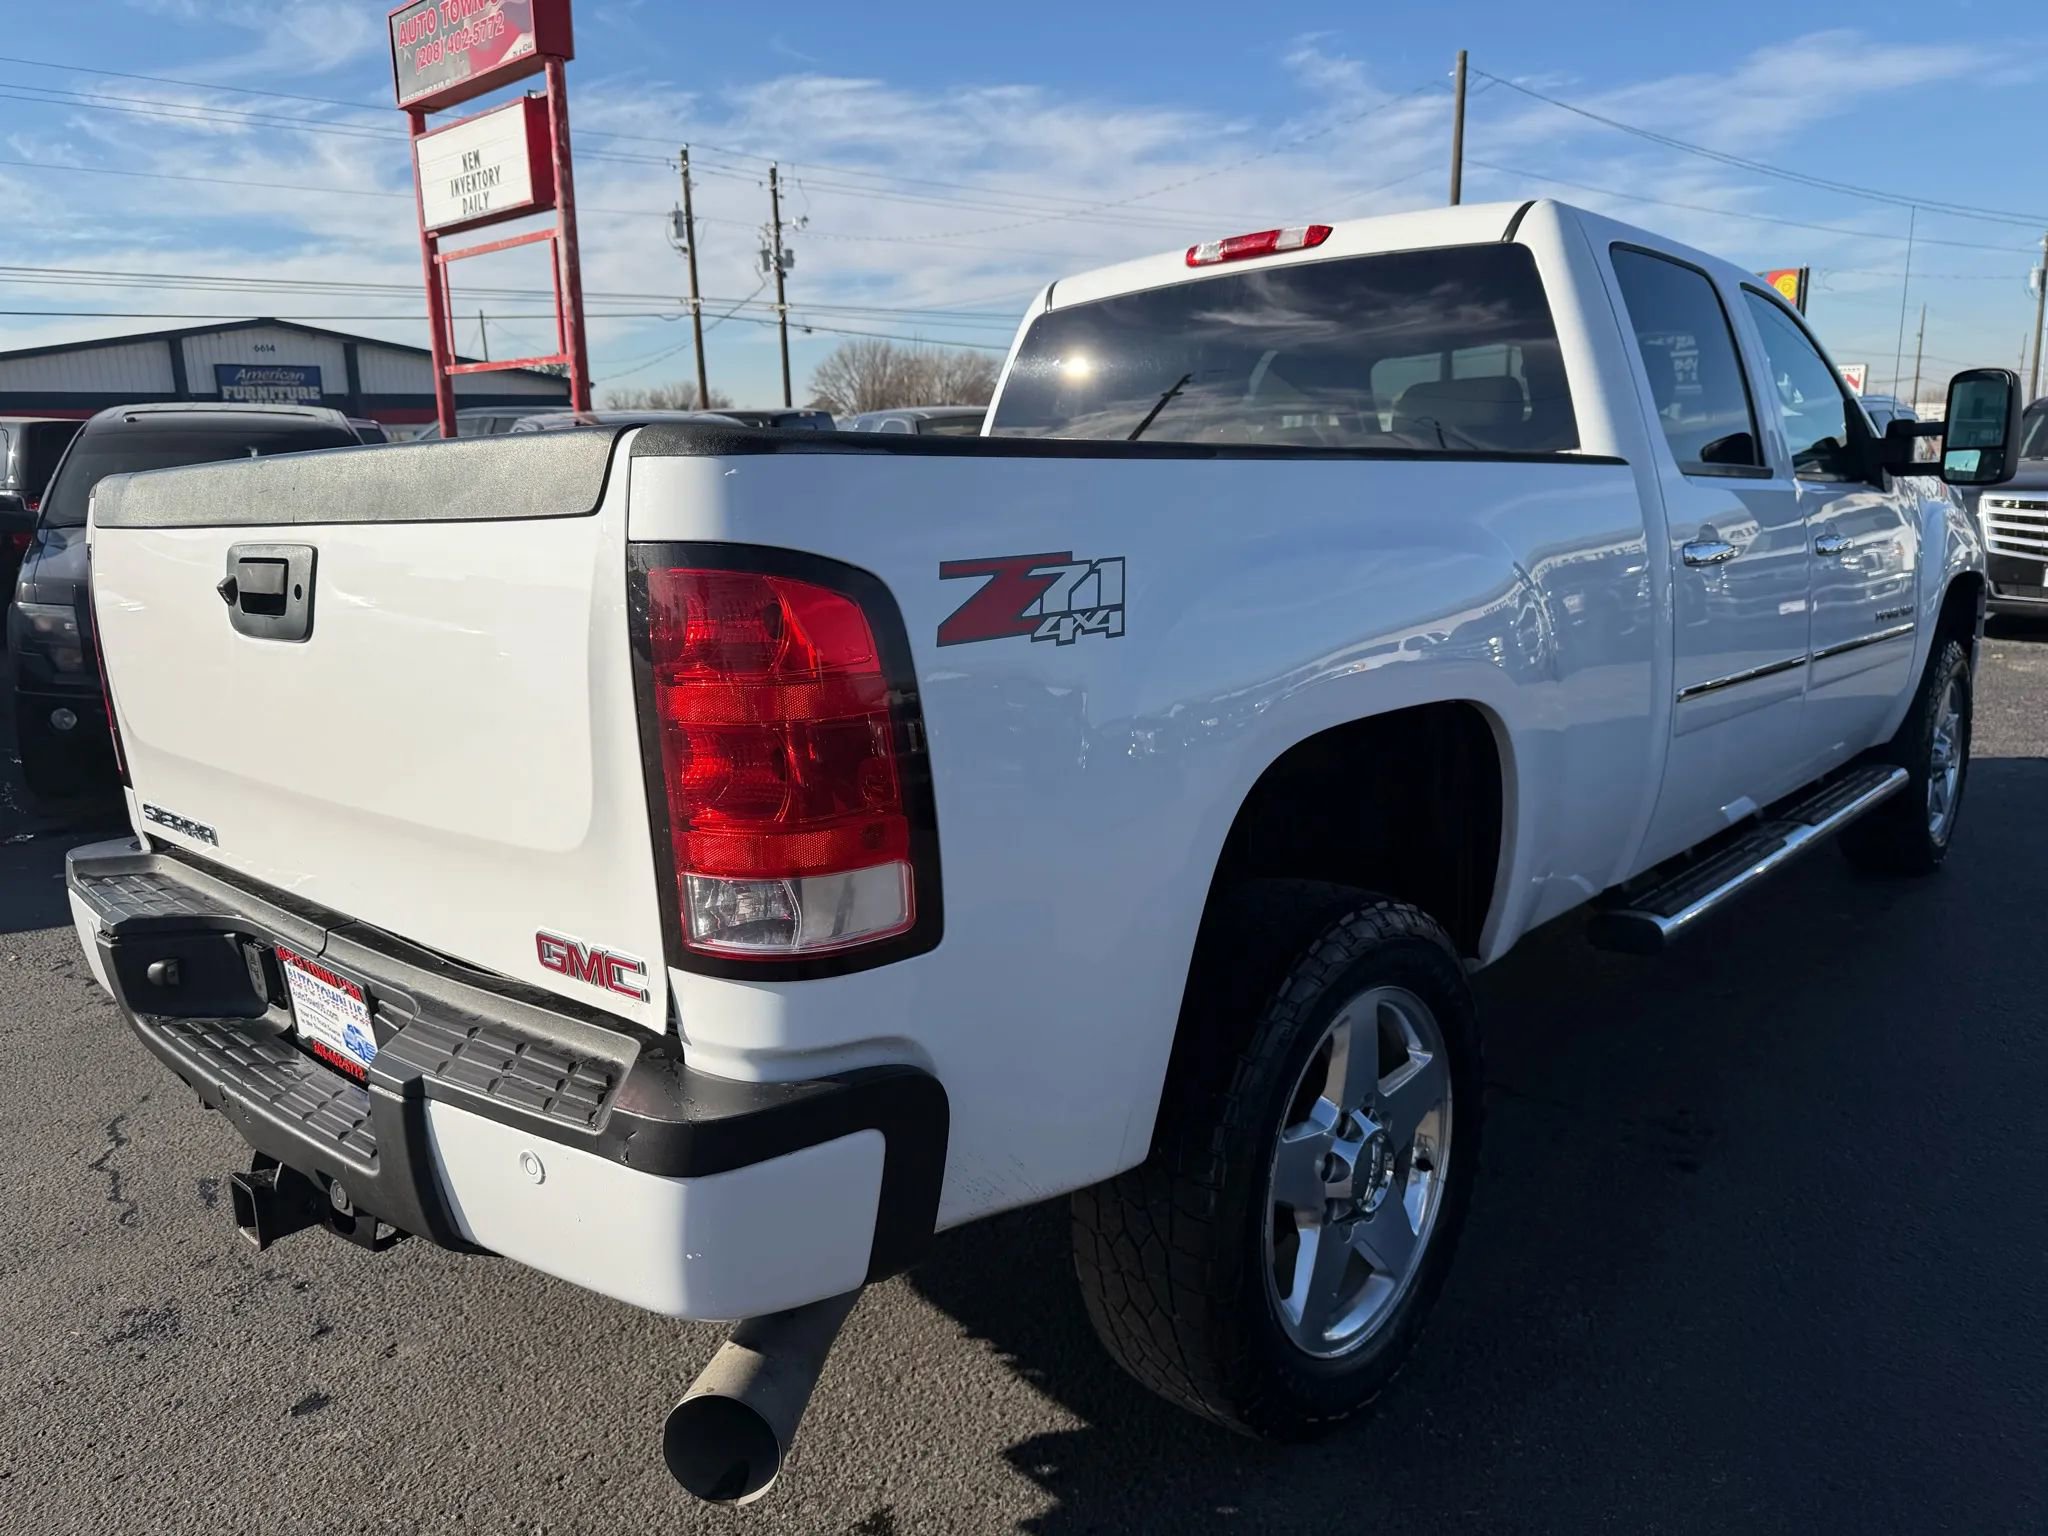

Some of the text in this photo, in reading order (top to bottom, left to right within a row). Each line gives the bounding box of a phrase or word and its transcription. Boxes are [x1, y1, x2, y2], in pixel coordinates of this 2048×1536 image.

[399, 8, 437, 47] AUTO
[416, 10, 504, 75] (208) 402-5772
[462, 150, 481, 174] NEW
[450, 165, 501, 198] INVENTORY
[463, 191, 489, 216] DAILY
[235, 368, 305, 381] American
[222, 386, 320, 400] FURNITURE
[937, 551, 1125, 647] Z71
[143, 804, 219, 847] SIERRA
[536, 930, 650, 1004] GMC
